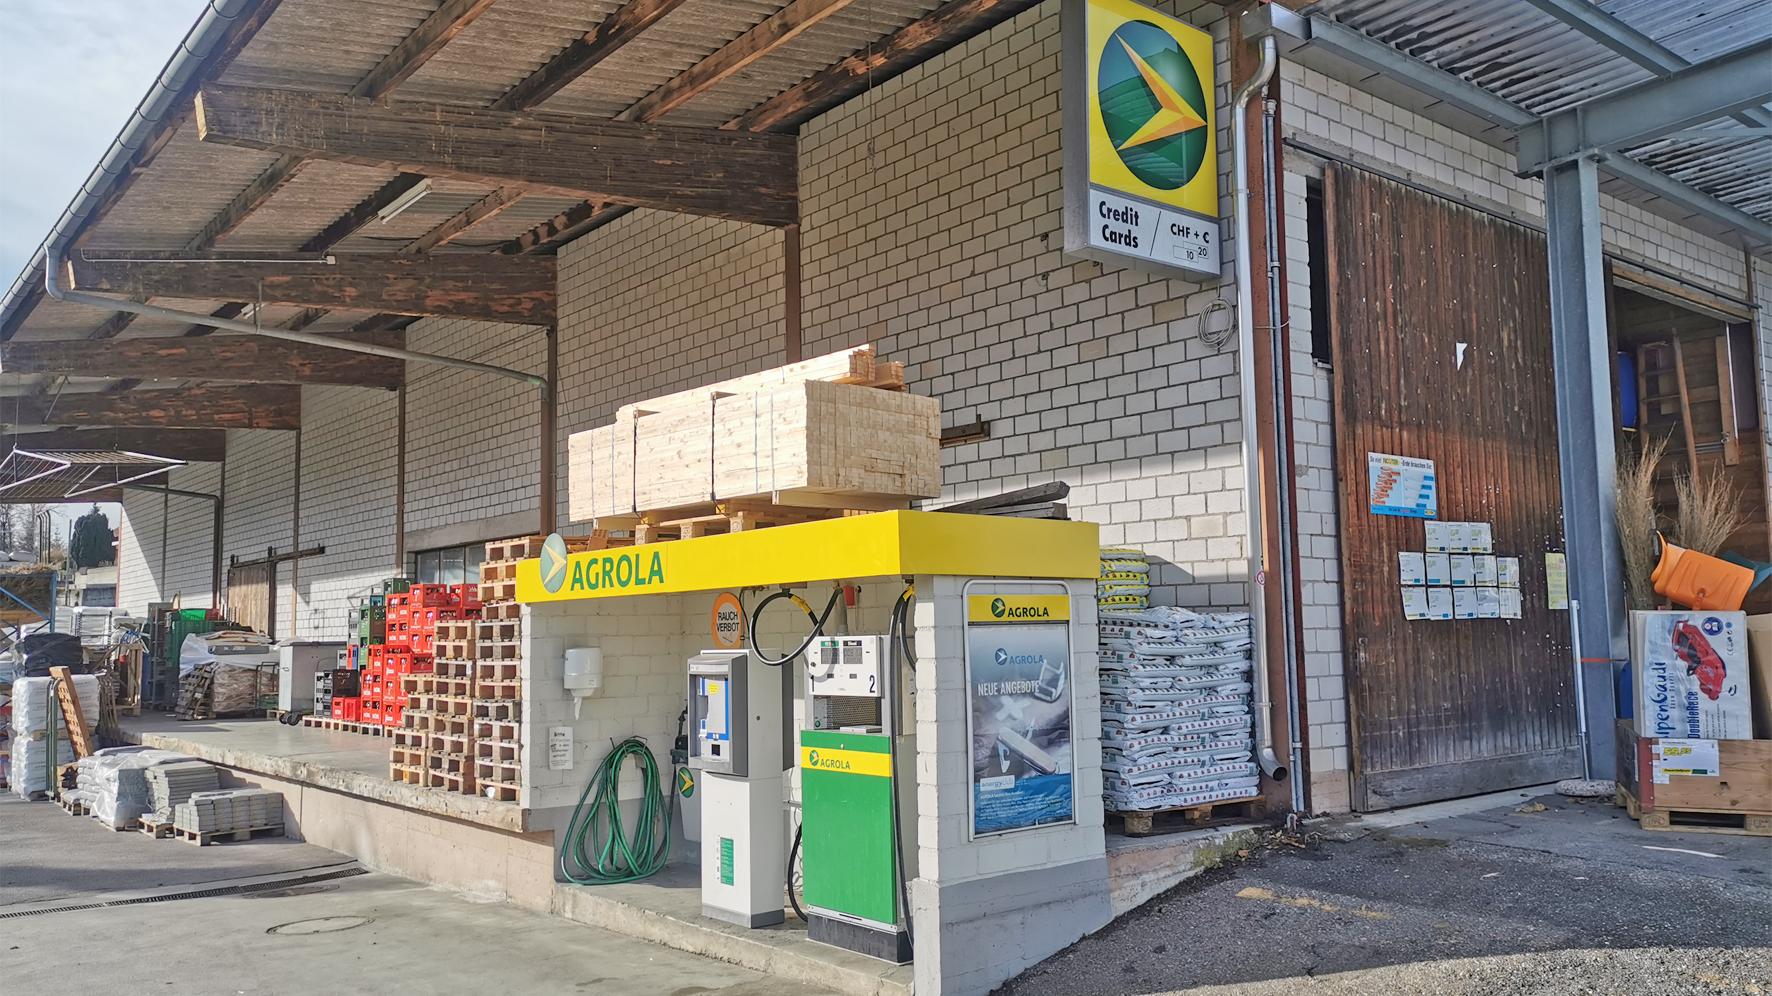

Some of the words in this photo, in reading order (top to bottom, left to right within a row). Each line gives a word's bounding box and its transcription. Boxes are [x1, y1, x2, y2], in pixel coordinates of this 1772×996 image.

[1099, 201, 1139, 226] Credit
[1102, 224, 1139, 248] Cards
[1171, 223, 1191, 238] CHF
[1186, 251, 1194, 260] 10
[1198, 247, 1208, 257] 20
[570, 551, 665, 591] AGROLA
[717, 611, 738, 621] RAUCH
[1007, 607, 1050, 618] AGROLA
[717, 622, 740, 632] VERBOT
[1009, 655, 1045, 665] AGROLA
[869, 675, 876, 693] 2
[978, 683, 998, 697] NEUE
[1000, 680, 1040, 695] ANGEBOTE
[820, 758, 851, 770] AGROLA
